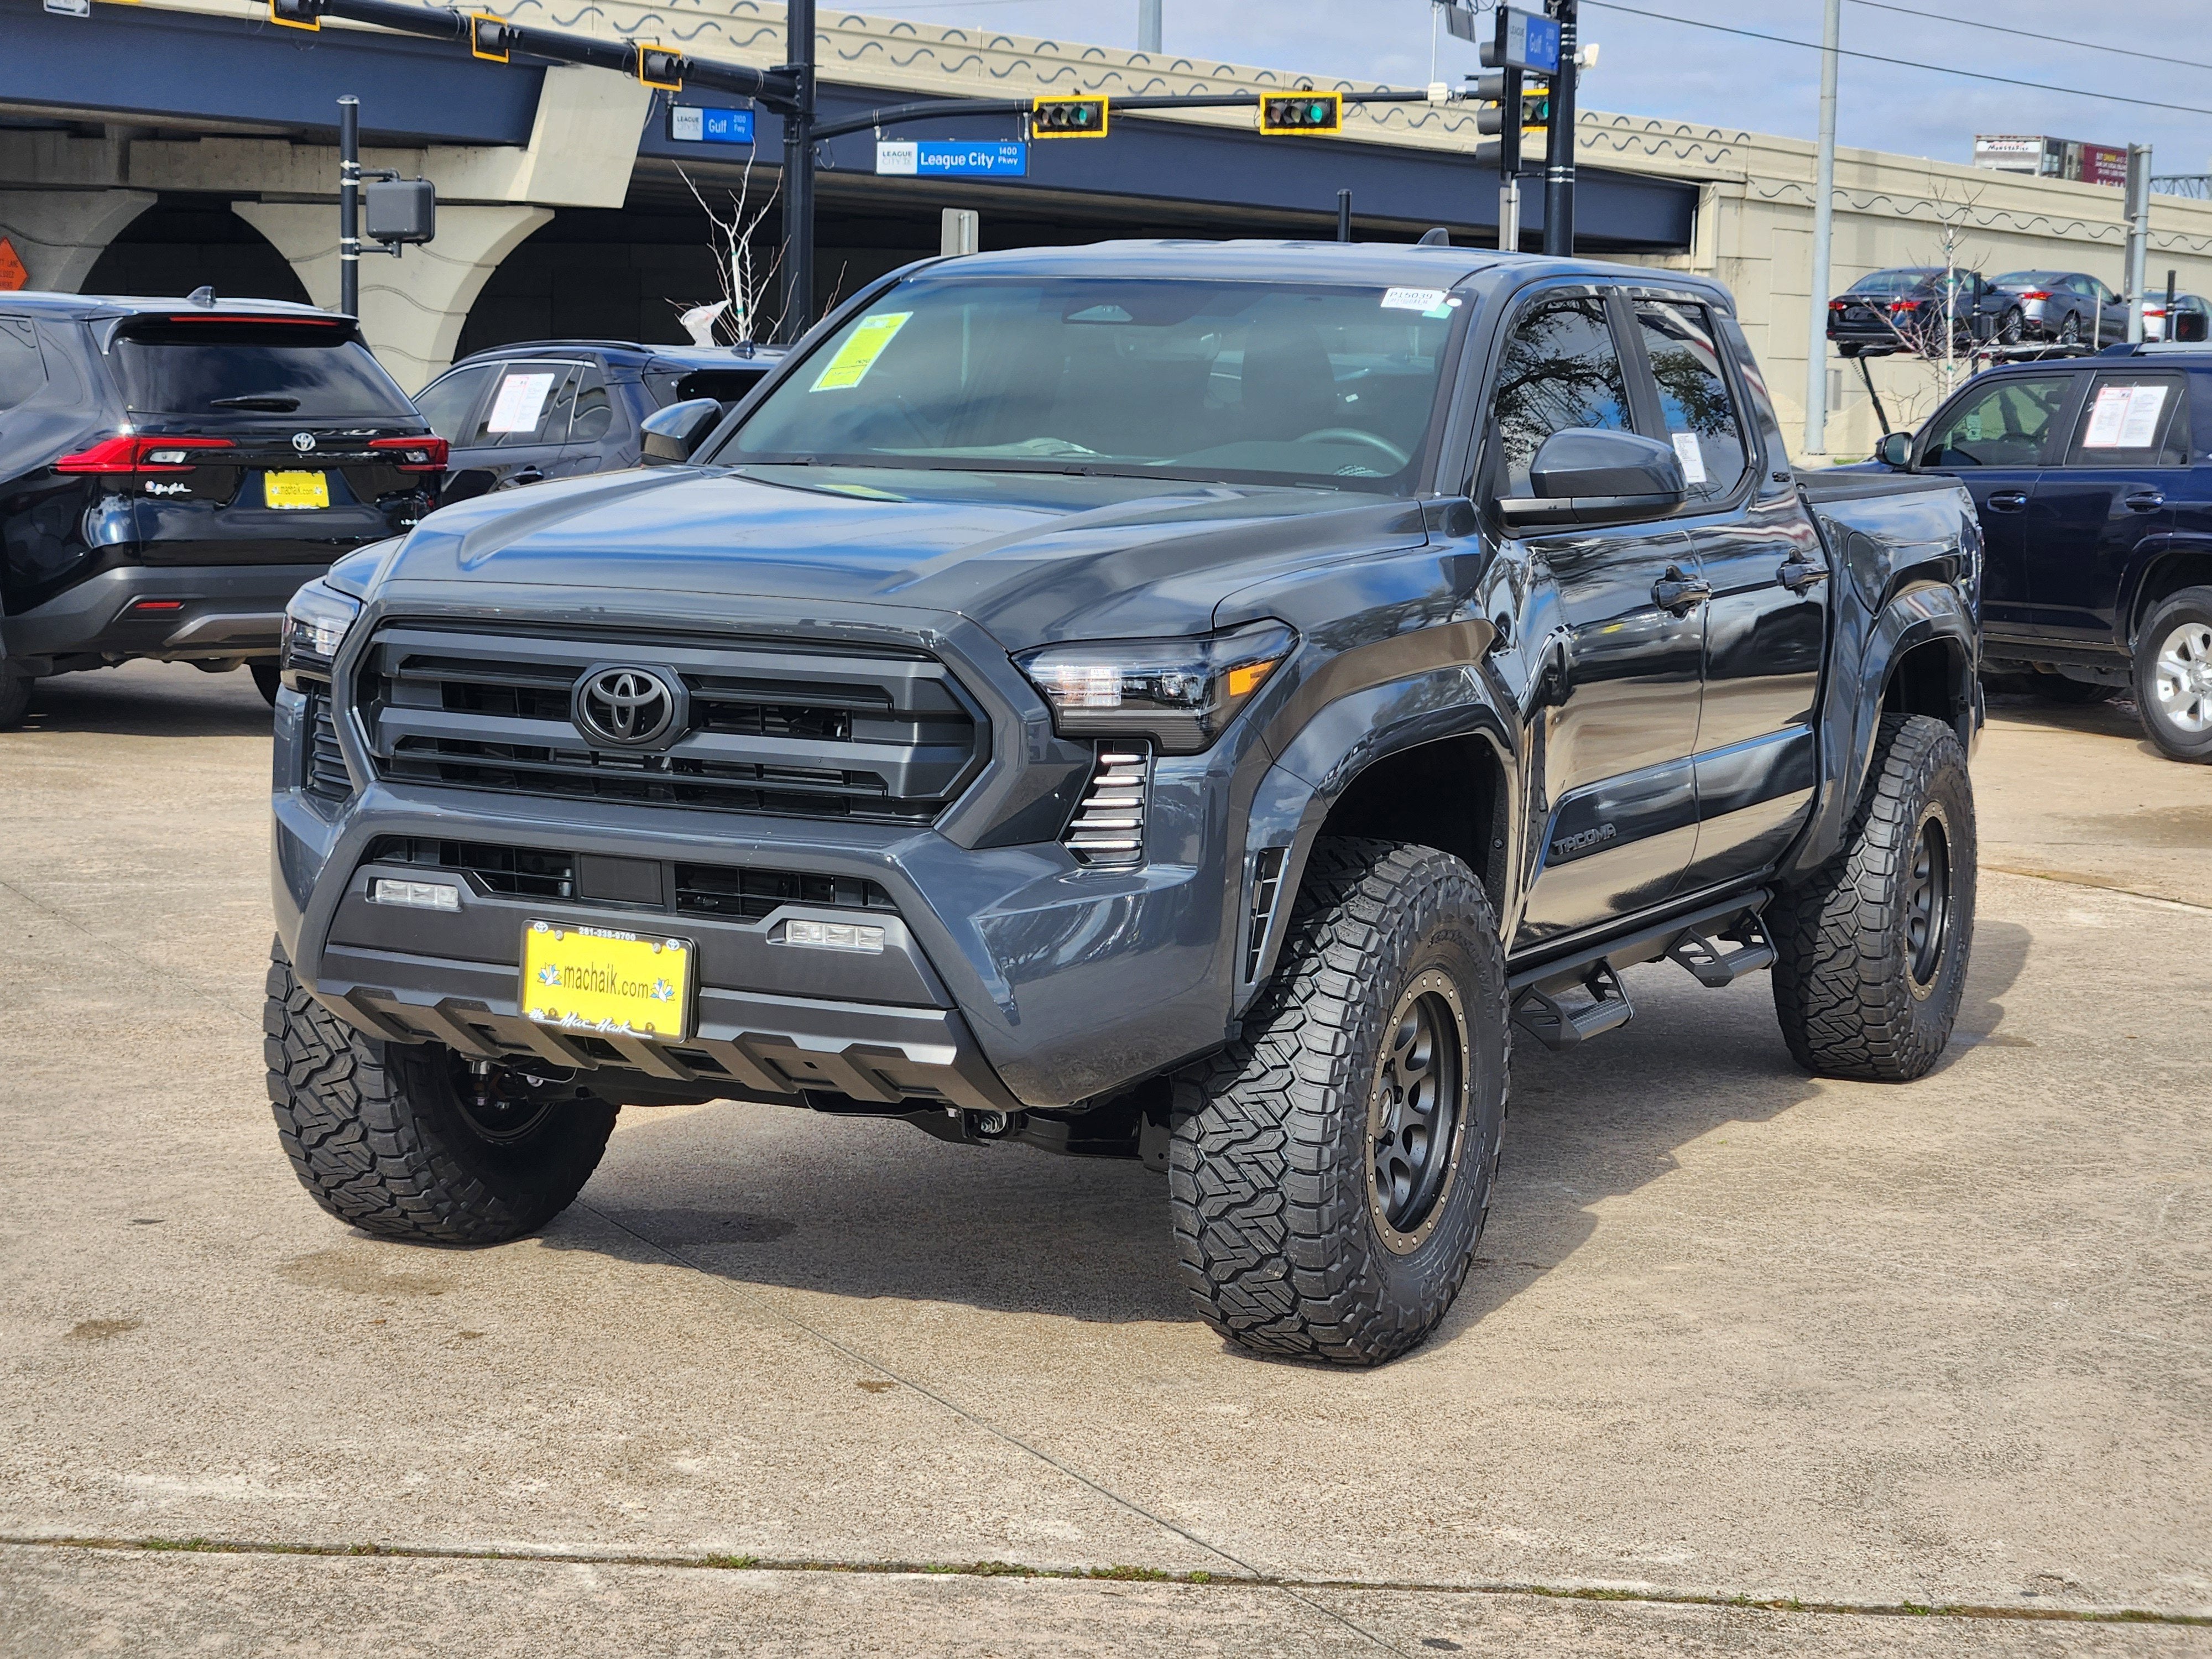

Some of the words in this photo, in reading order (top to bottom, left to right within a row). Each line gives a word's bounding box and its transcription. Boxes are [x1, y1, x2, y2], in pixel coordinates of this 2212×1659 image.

[708, 118, 727, 133] Gulf
[999, 147, 1018, 155] 1400
[920, 152, 966, 170] League
[968, 152, 994, 169] City
[998, 156, 1018, 165] Pkwy
[1552, 823, 1616, 854] TACOMA
[564, 962, 649, 999] machaik.com
[560, 1011, 594, 1027] Mac
